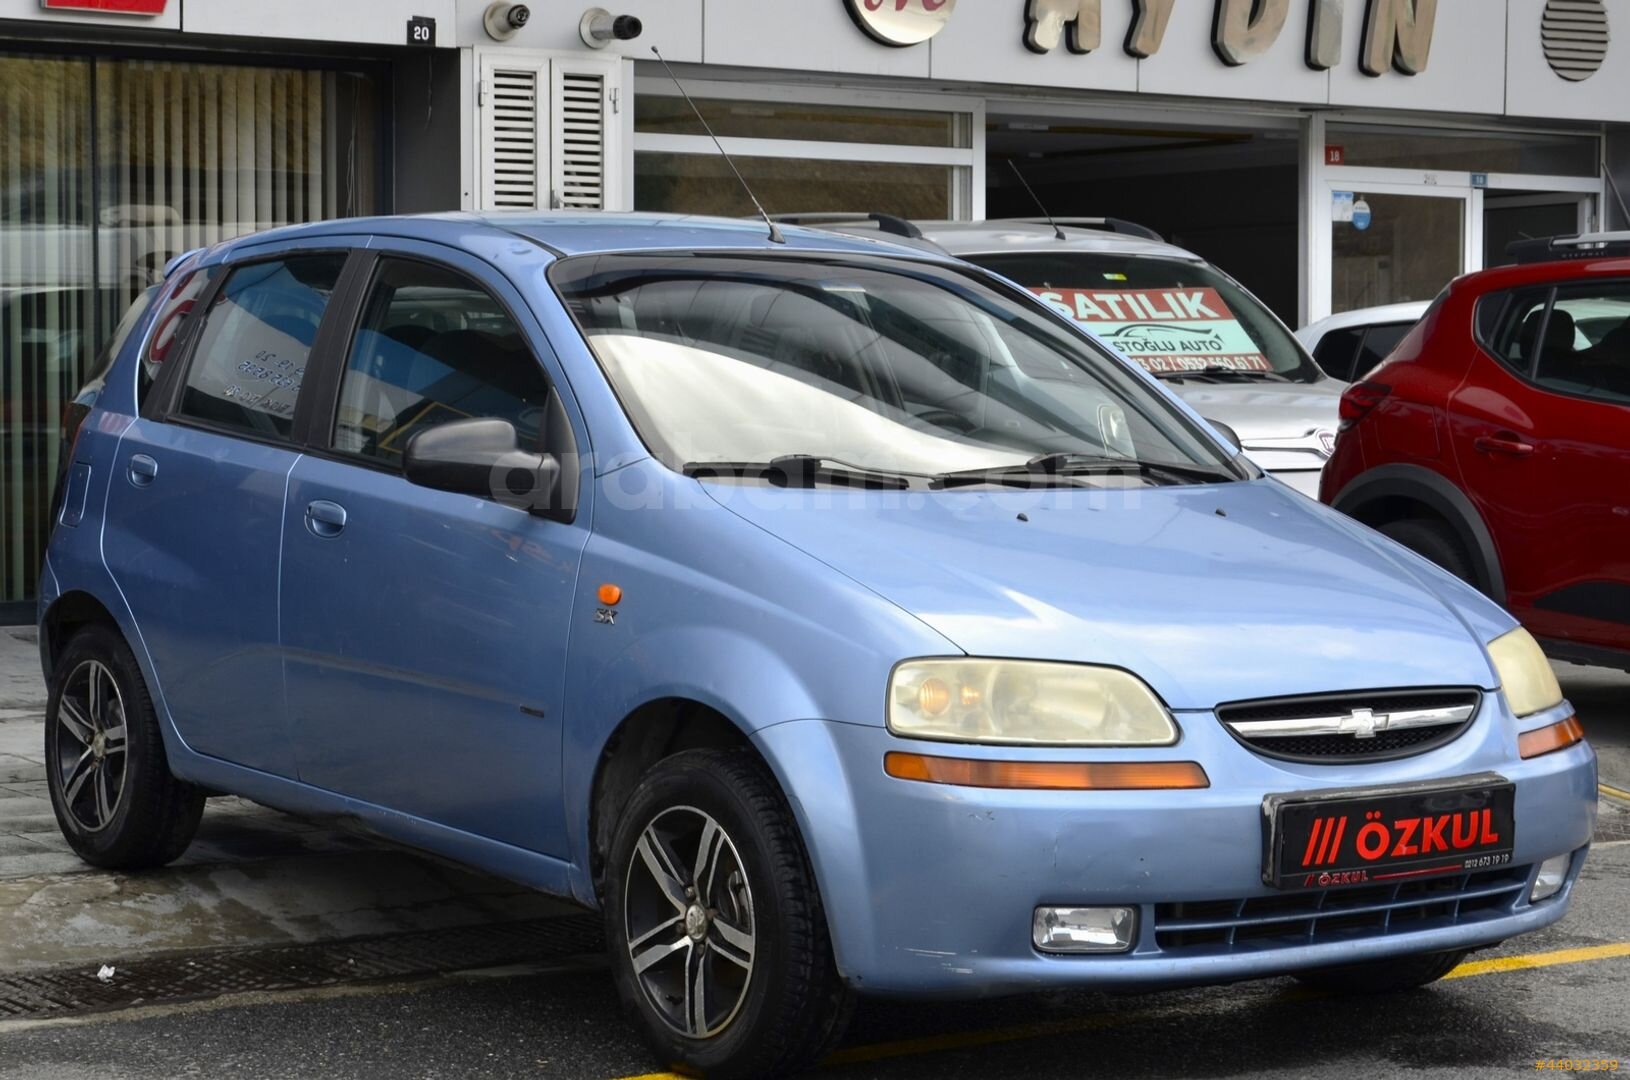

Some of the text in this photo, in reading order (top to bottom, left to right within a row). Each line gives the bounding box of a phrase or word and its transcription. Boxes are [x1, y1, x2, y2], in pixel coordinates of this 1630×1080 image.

[414, 26, 429, 40] 20
[1330, 151, 1340, 162] 18
[1038, 292, 1220, 320] SATILIK
[1113, 337, 1223, 352] STOĞLU AUTO
[1151, 357, 1168, 371] 02
[1250, 356, 1267, 370] 71
[1356, 808, 1499, 861] ÖZKUL
[1319, 870, 1369, 887] ÖZKUL
[1479, 856, 1491, 867] 673
[1492, 855, 1500, 864] 19
[1501, 853, 1510, 863] 19
